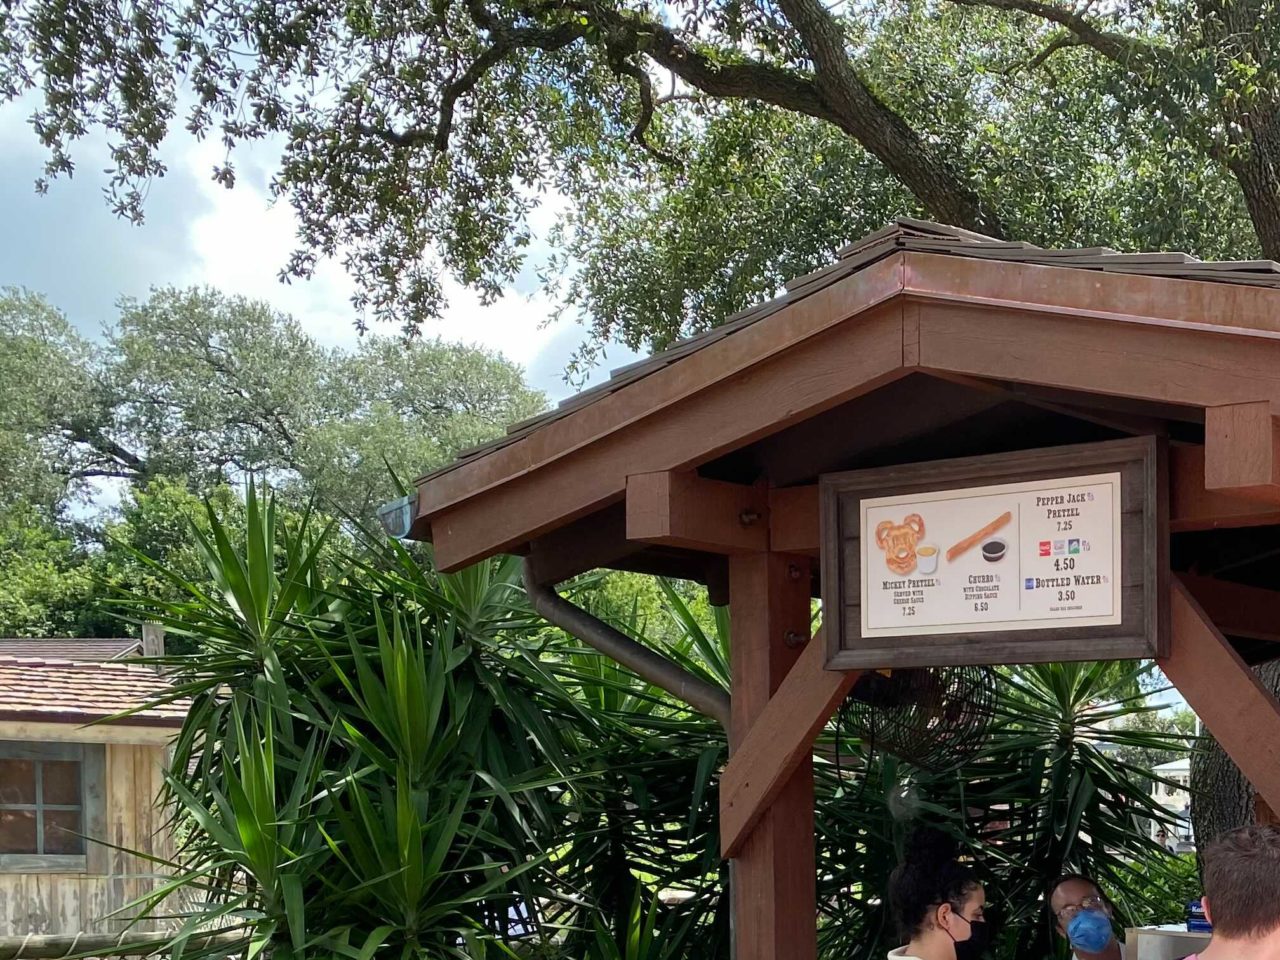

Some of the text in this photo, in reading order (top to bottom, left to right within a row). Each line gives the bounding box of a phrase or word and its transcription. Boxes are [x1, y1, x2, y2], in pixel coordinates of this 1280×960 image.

[1036, 493, 1086, 507] PEPPER JACK
[1047, 508, 1080, 519] PRETZEL
[1057, 520, 1073, 531] 7.25
[1054, 557, 1075, 571] 4.50
[882, 578, 935, 590] MICKEY PRETZEL
[968, 574, 993, 584] CHURRO
[1035, 577, 1071, 588] BOTTLED
[1074, 575, 1101, 586] WATER
[1058, 590, 1076, 601] 3.50
[902, 606, 916, 616] 7.25
